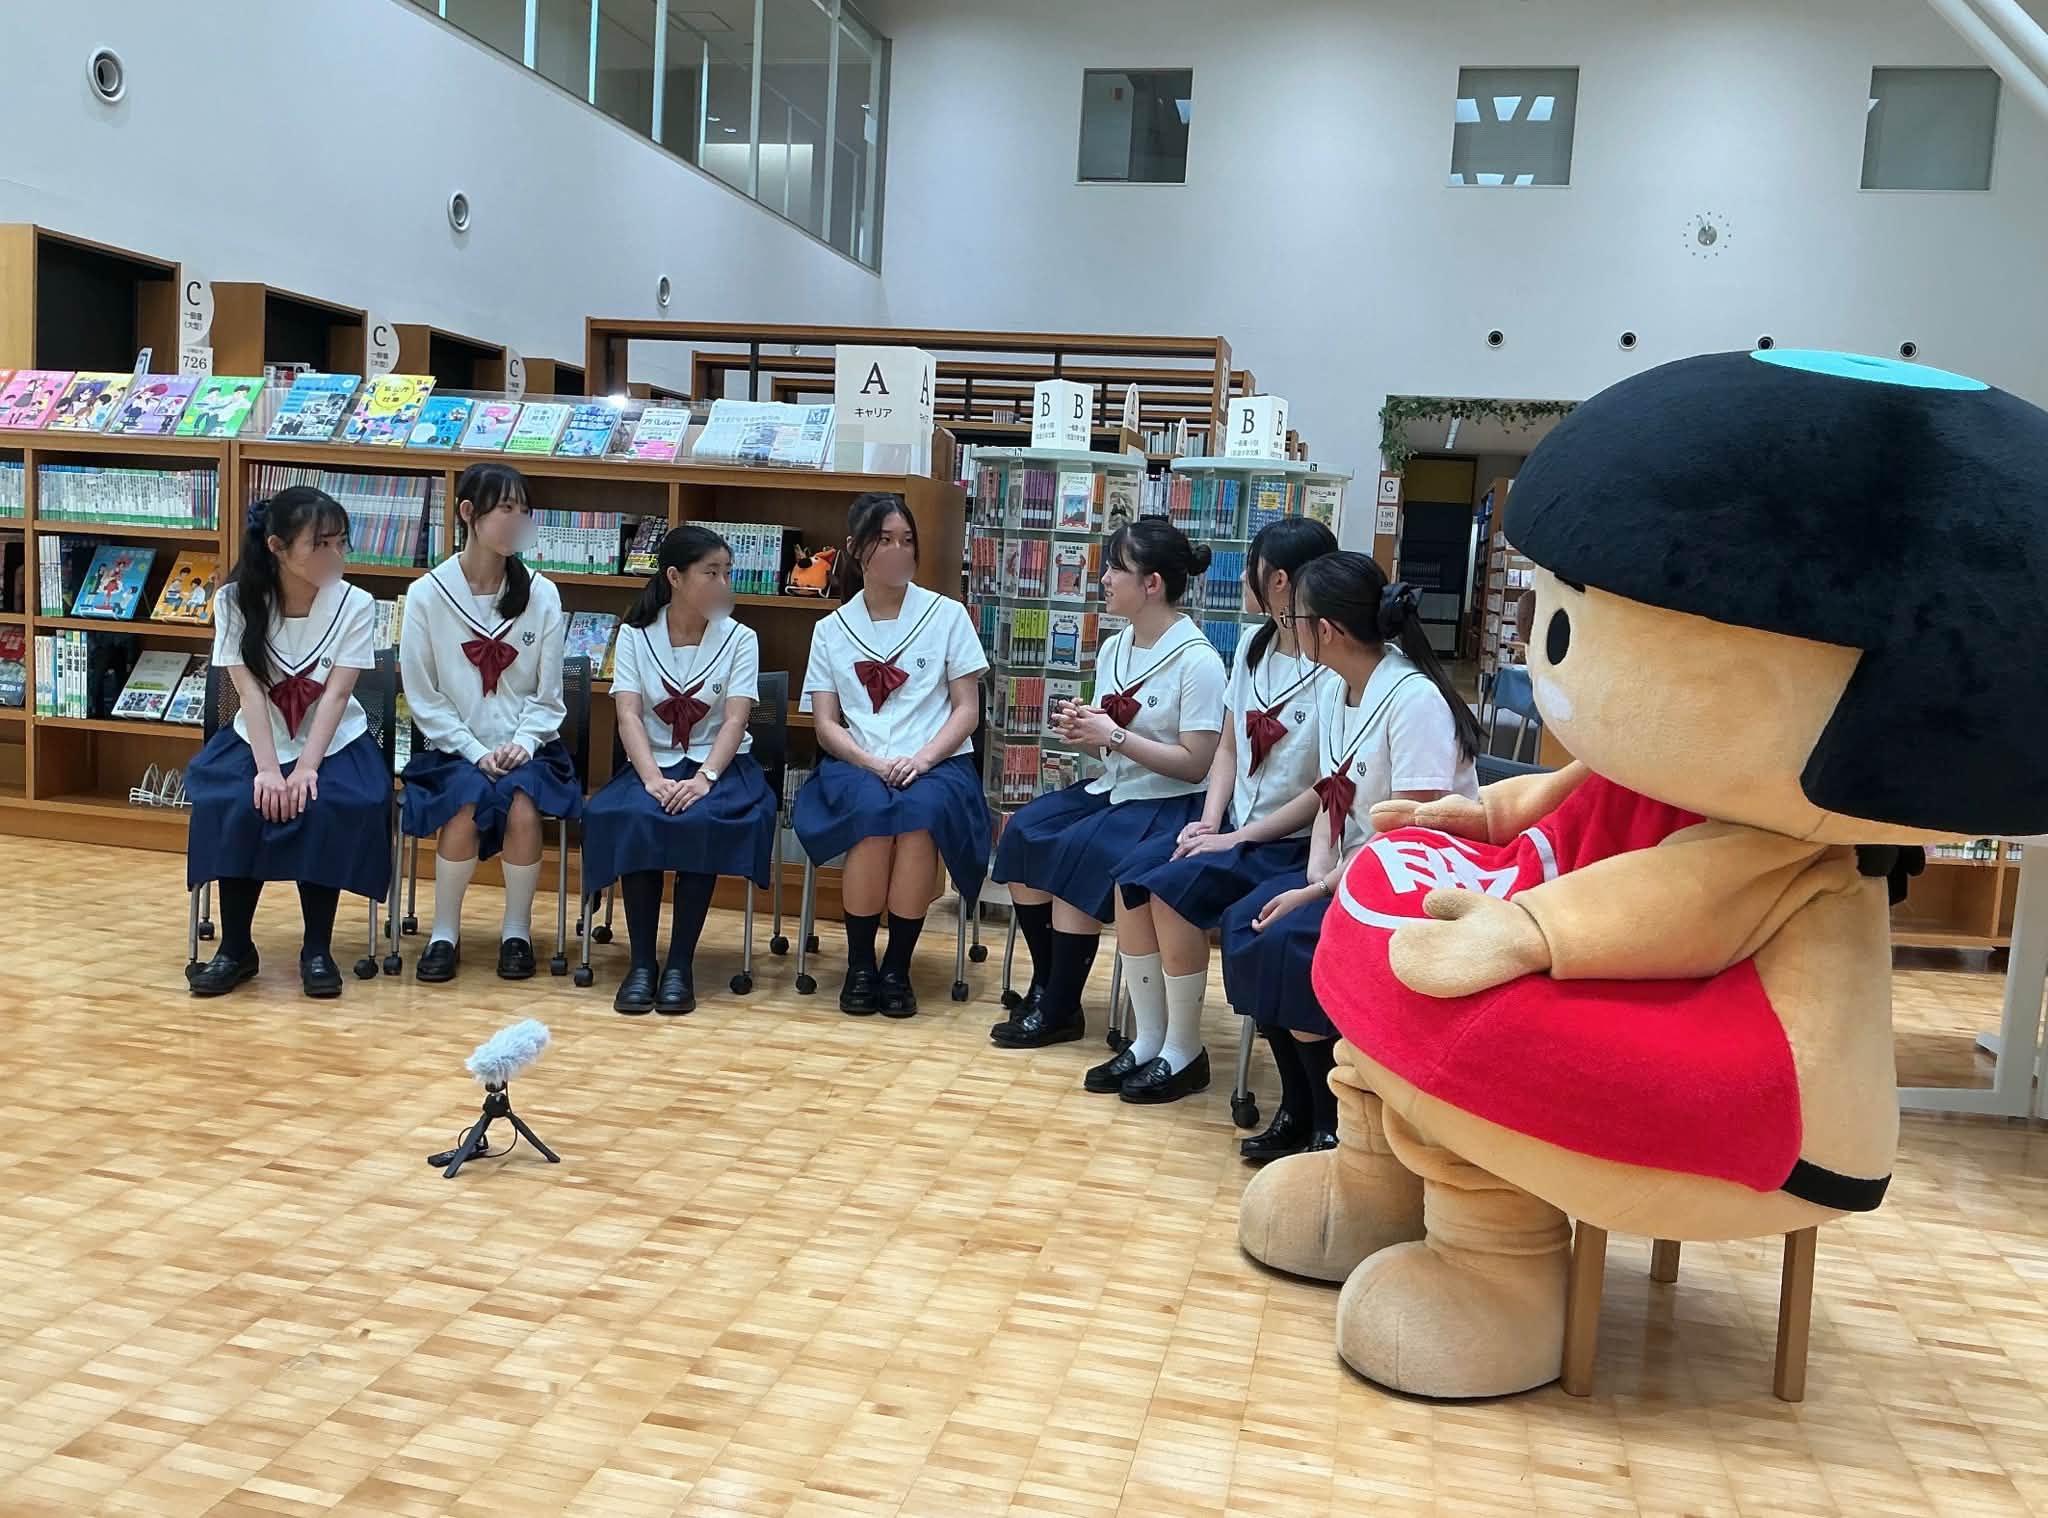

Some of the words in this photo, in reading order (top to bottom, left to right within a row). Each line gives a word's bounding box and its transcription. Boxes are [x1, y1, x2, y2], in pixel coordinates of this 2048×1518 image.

[186, 281, 202, 306] C
[373, 325, 388, 347] C
[183, 355, 208, 369] 726
[510, 359, 519, 378] C
[860, 361, 890, 395] A
[920, 363, 930, 406] A
[854, 407, 893, 418] キャリア
[1041, 391, 1051, 417] B
[1073, 393, 1084, 419] B
[1241, 408, 1255, 434] B
[1276, 409, 1284, 436] B
[1384, 480, 1394, 493] G
